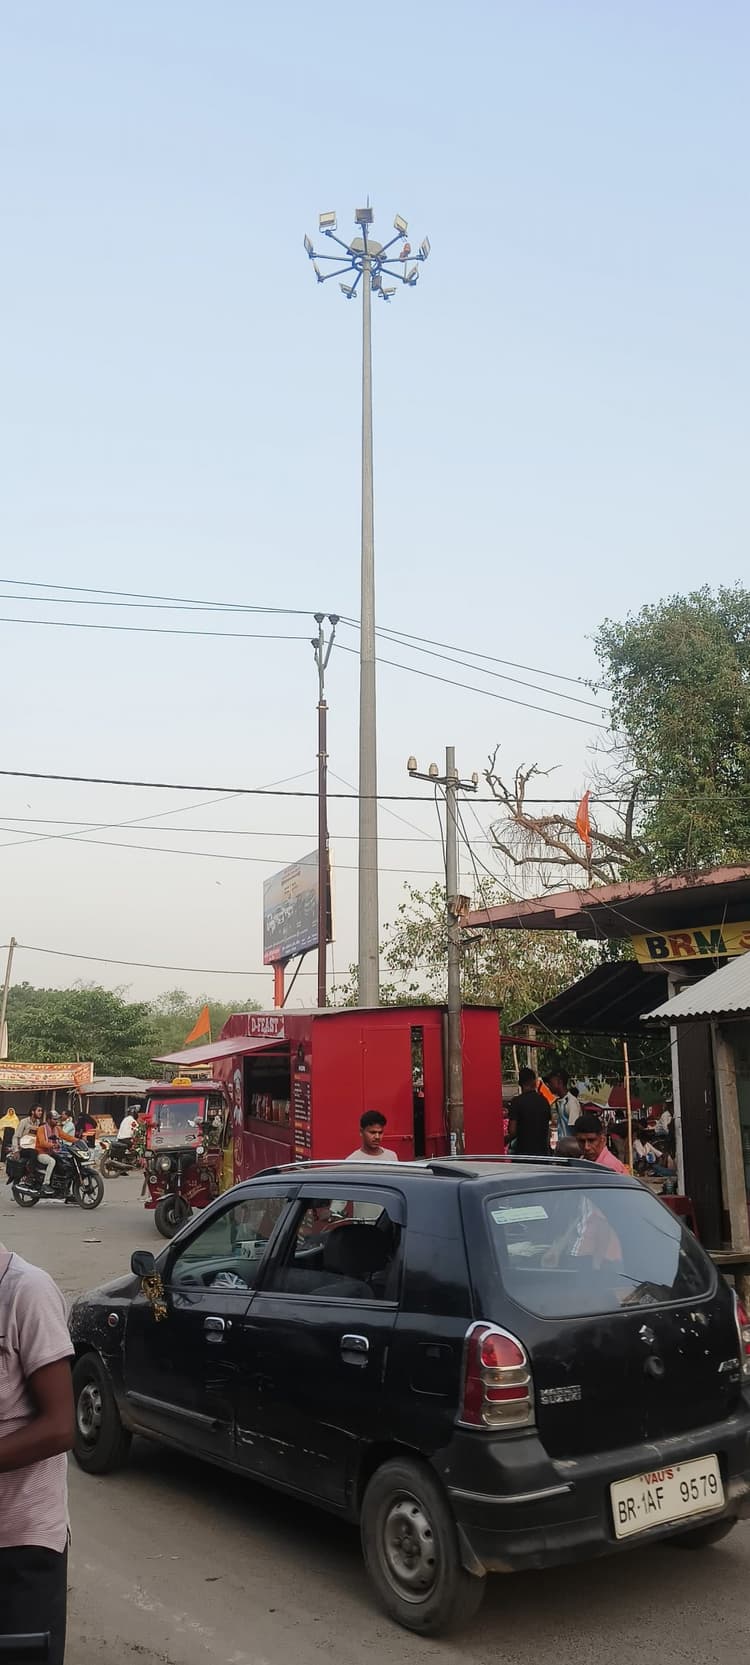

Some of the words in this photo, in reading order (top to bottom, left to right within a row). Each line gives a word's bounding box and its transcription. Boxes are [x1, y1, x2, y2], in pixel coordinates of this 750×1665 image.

[645, 929, 727, 959] BRM
[251, 1017, 279, 1033] D-FEAST
[540, 1393, 582, 1404] SUZUKI
[680, 1473, 718, 1502] 9579
